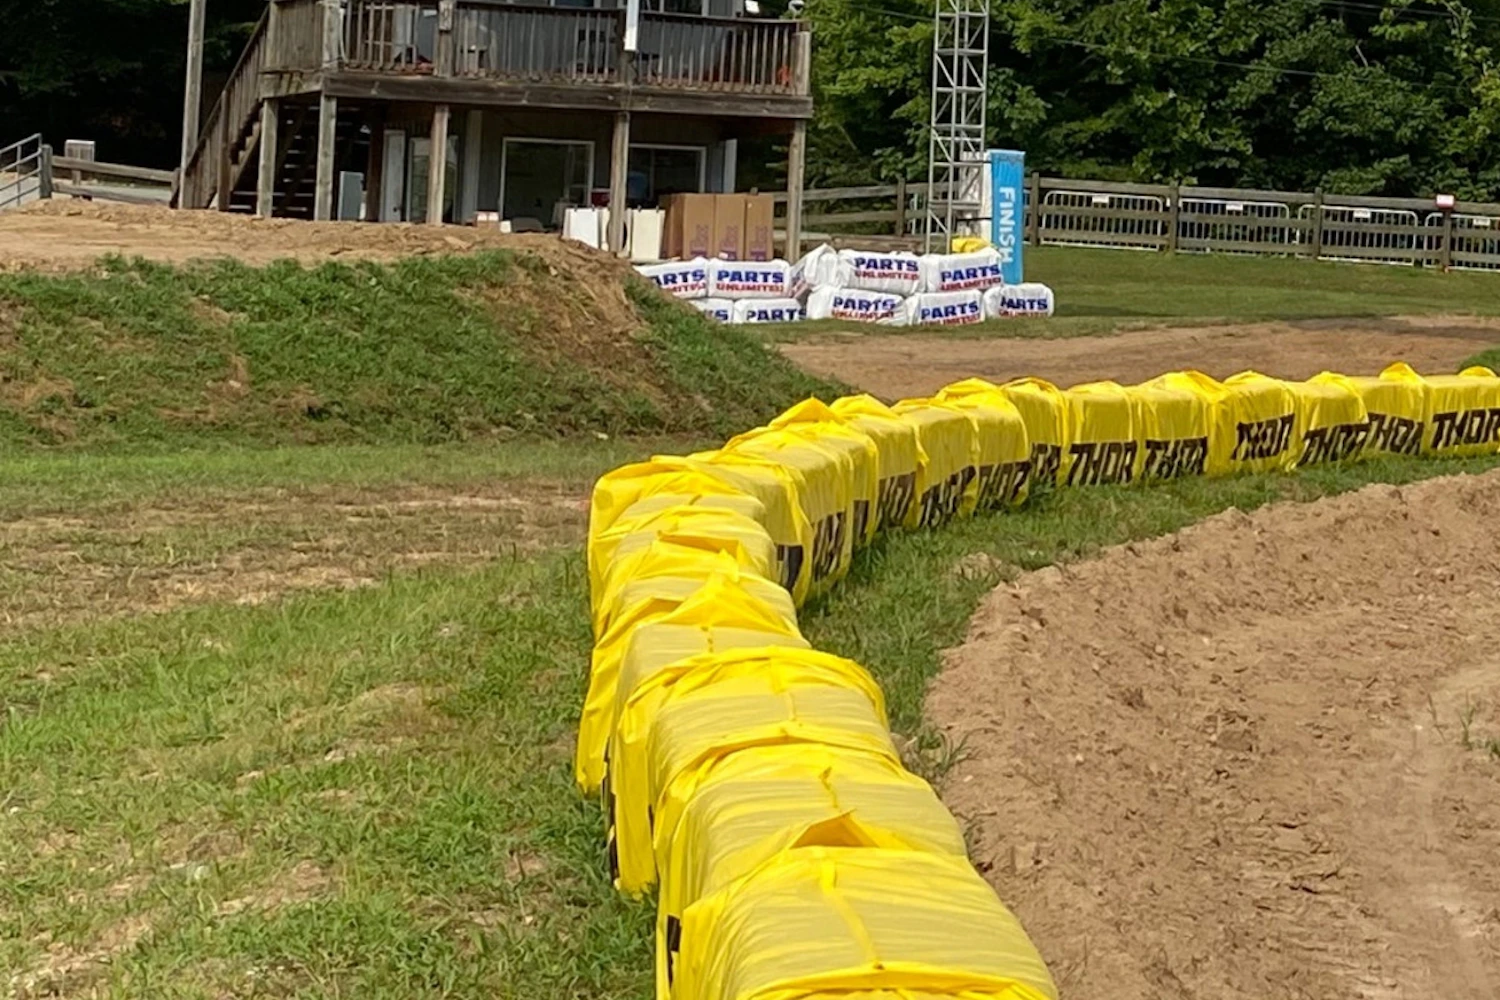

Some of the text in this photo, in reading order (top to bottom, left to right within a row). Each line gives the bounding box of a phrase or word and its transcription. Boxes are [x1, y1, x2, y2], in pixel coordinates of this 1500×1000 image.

[999, 186, 1015, 264] FINISH
[854, 256, 919, 272] PARTS
[651, 268, 706, 287] ARTS
[717, 269, 784, 283] PARTS
[854, 269, 919, 281] UNLIMITED
[940, 264, 1001, 283] PARTS
[833, 296, 897, 313] PARTS
[920, 300, 979, 320] PARTS
[1000, 297, 1049, 311] PARTS
[746, 308, 807, 322] PARTS
[1366, 412, 1425, 456] THOR
[1068, 440, 1137, 486] THOR
